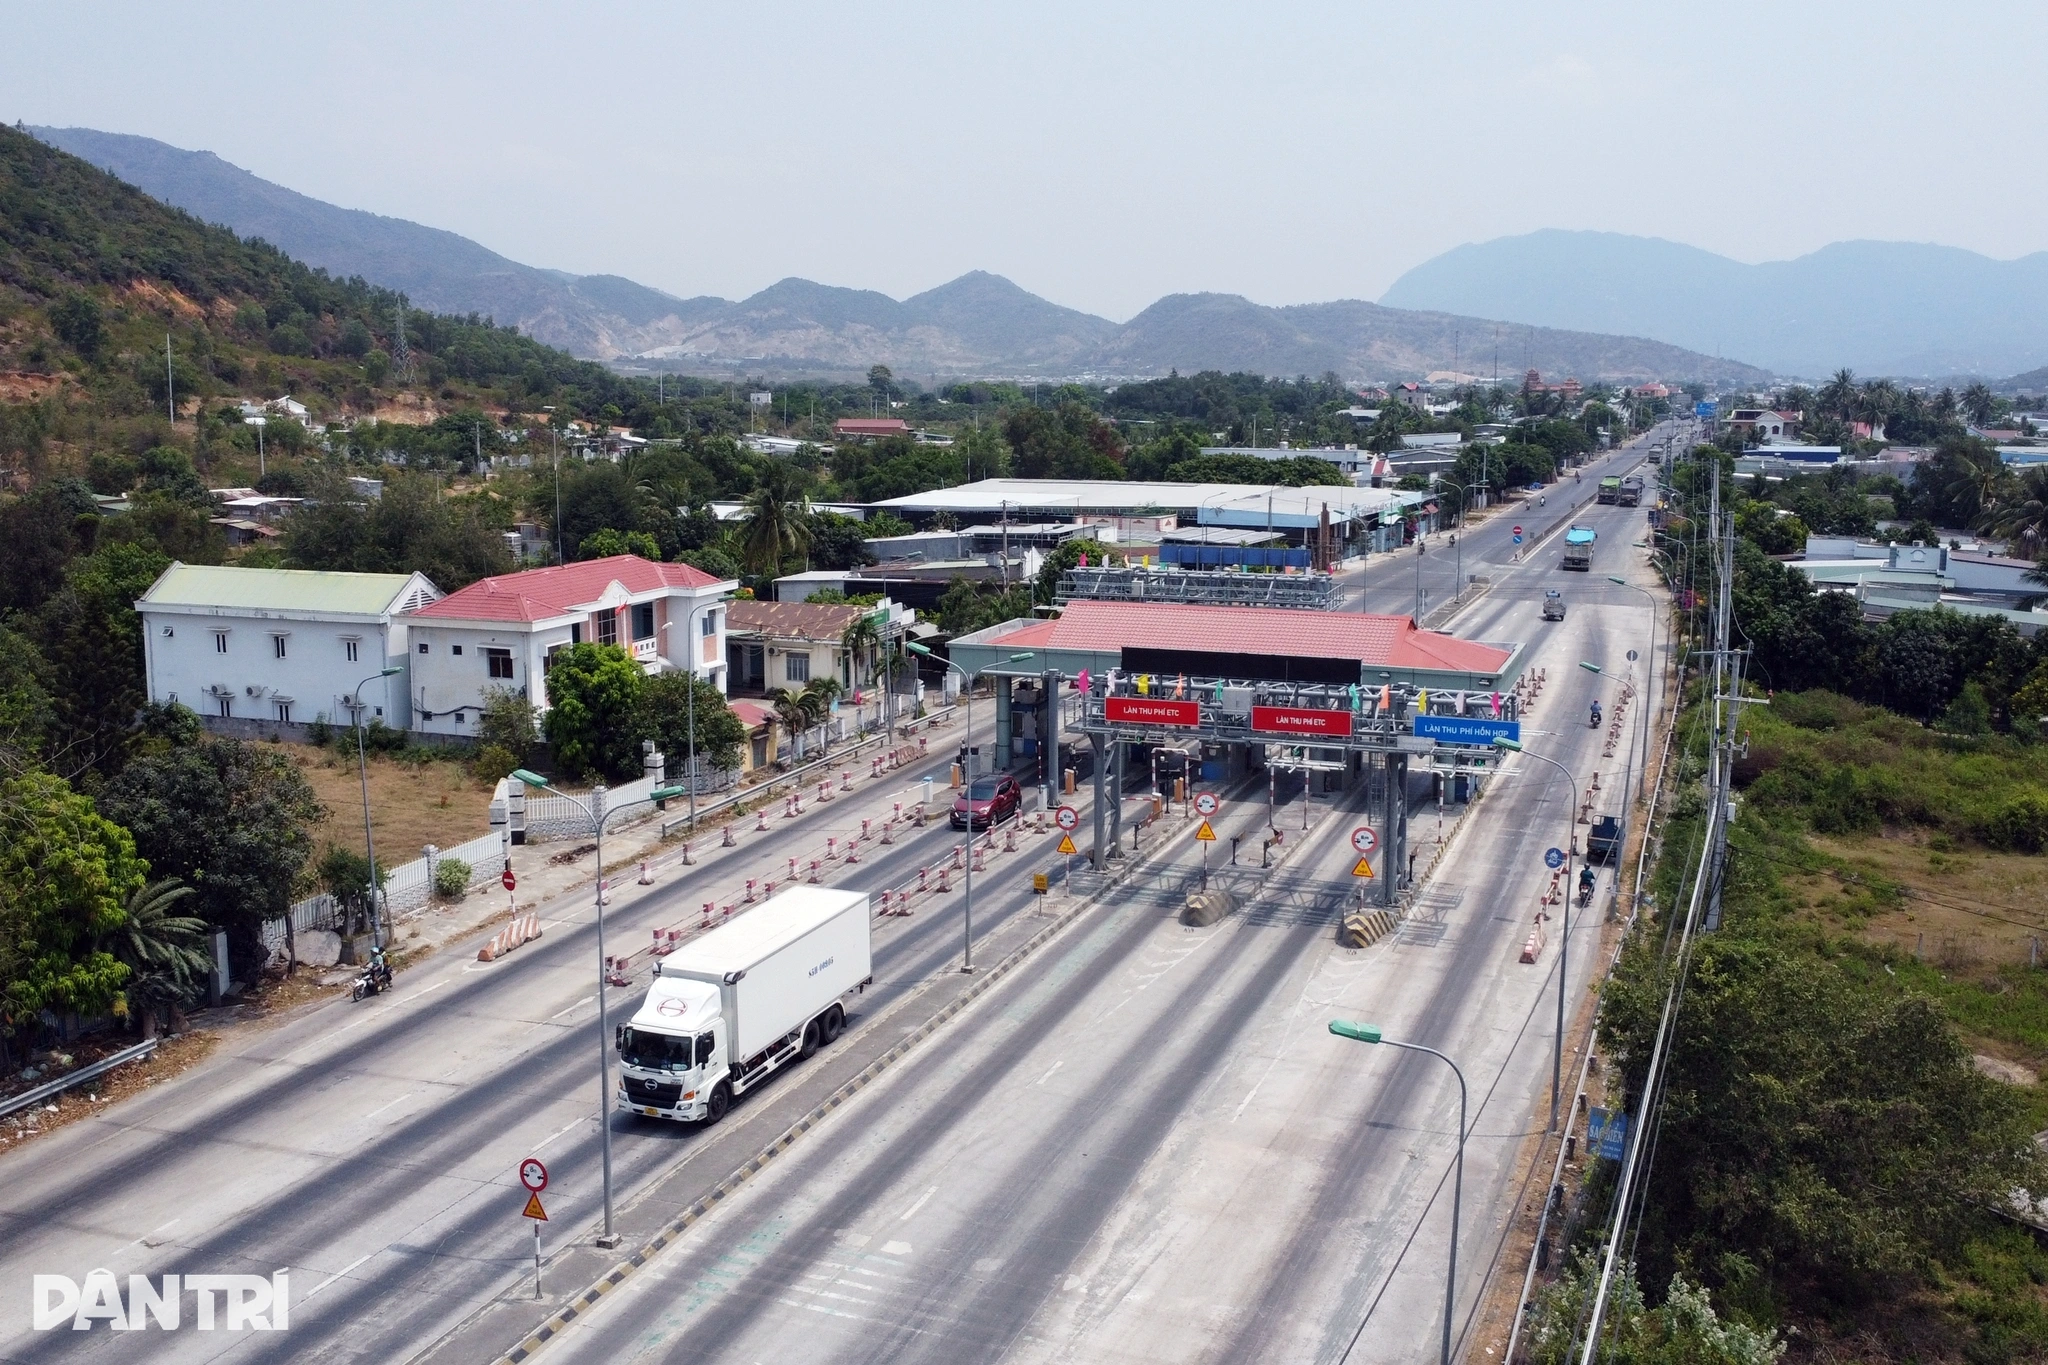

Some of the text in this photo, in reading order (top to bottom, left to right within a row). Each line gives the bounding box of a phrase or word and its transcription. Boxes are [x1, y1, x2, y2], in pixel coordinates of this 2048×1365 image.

[1123, 705, 1180, 717] LÀN THU PHÍ ETC
[1276, 715, 1326, 726] LÀN THU PHÍ ETC
[1424, 723, 1441, 733] LÀN
[1441, 726, 1457, 734] THU
[1459, 726, 1473, 735] PHÍ
